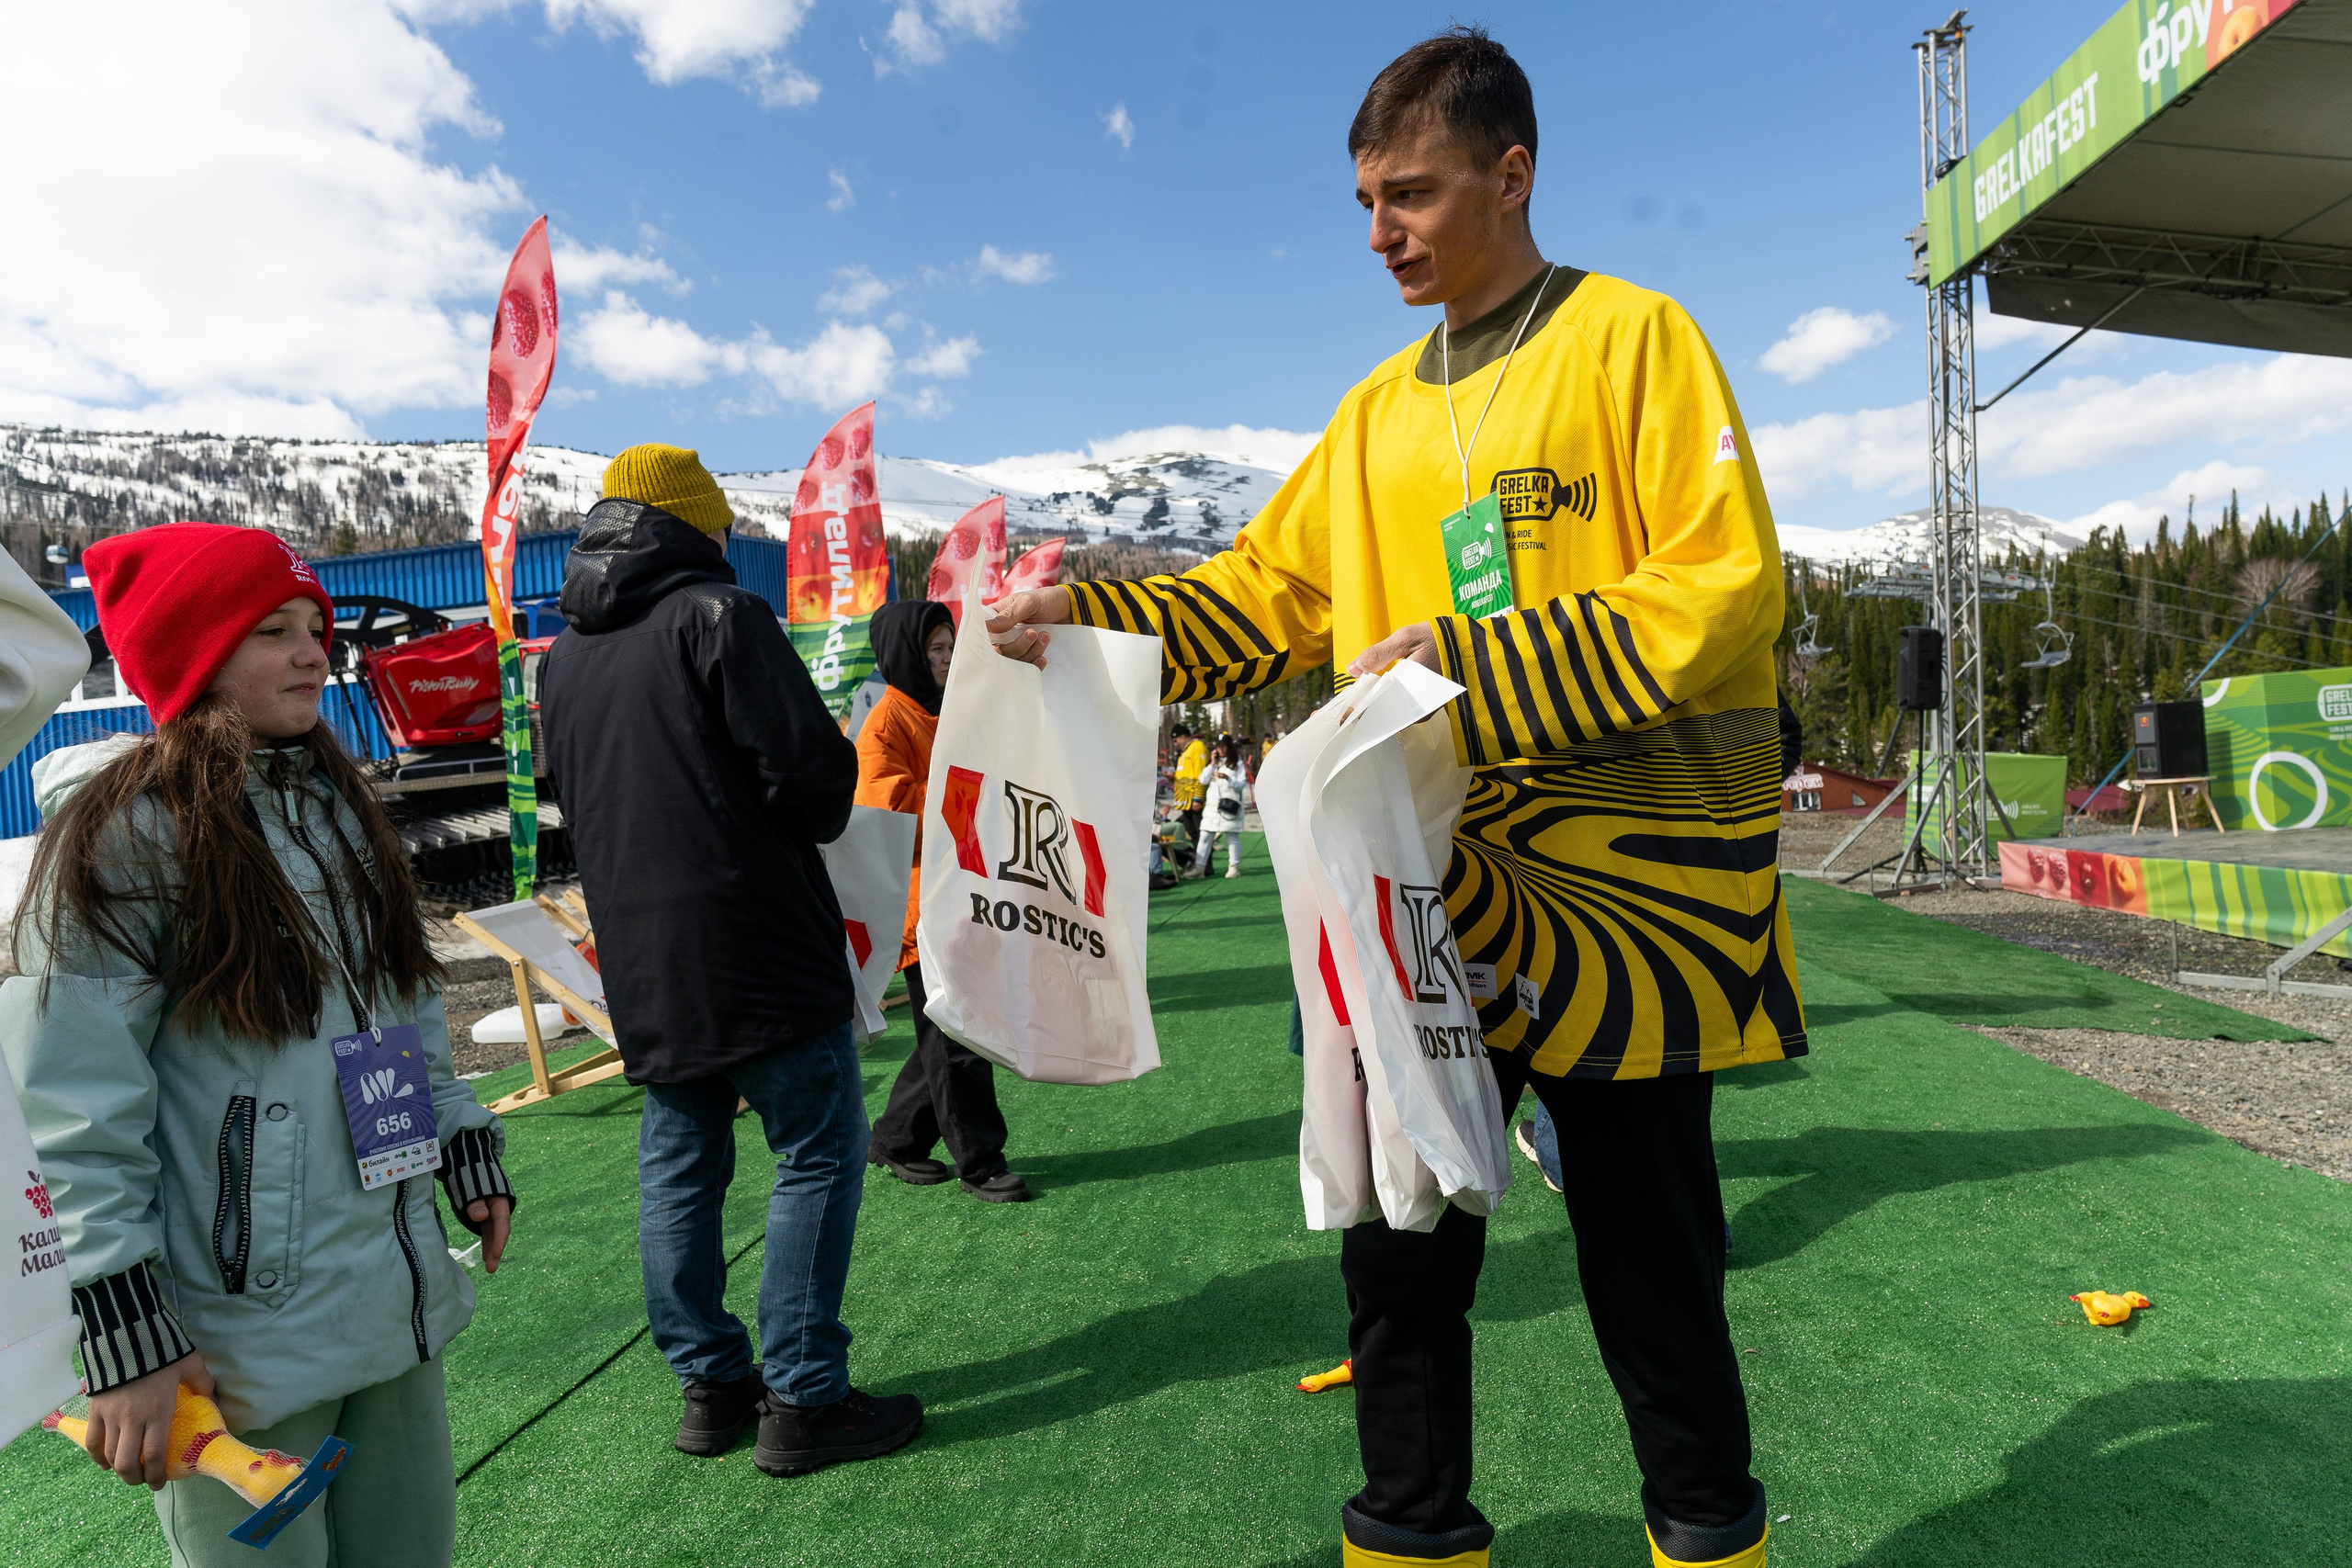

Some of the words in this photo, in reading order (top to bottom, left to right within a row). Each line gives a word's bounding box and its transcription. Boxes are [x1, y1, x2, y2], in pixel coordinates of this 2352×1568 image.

[2137, 0, 2233, 86] фру
[1973, 72, 2098, 223] GRELKAFEST
[1499, 475, 1550, 496] GRELKA
[1500, 495, 1532, 514] FEST
[1517, 529, 1532, 538] RIDE
[1507, 542, 1517, 552] SIC
[1518, 541, 1547, 551] FESTIVAL
[1458, 570, 1502, 603] КОМАНДА
[2325, 689, 2352, 704] GREL
[998, 779, 1077, 906] R
[970, 892, 1106, 959] ROSTIC'S
[376, 1111, 412, 1136] 656
[368, 1156, 390, 1168] билайн
